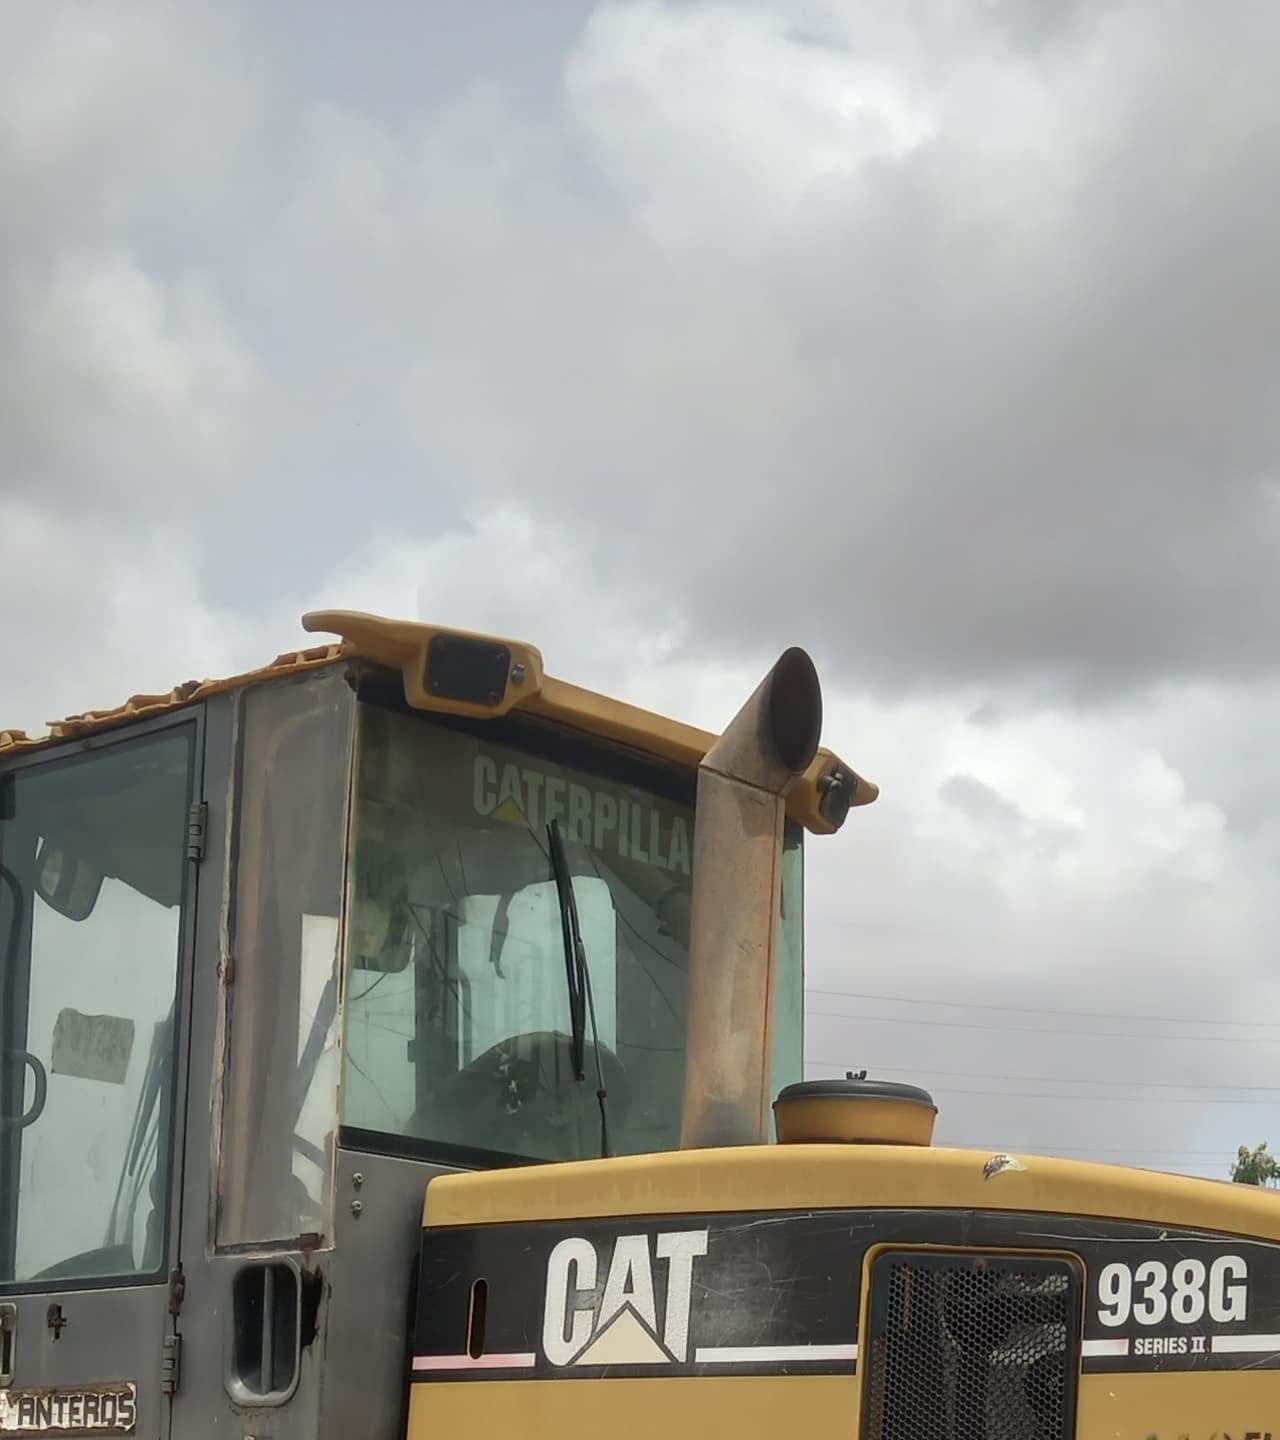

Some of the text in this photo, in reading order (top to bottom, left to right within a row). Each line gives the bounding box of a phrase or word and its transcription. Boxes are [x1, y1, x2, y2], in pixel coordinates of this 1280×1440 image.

[472, 755, 691, 876] CATERPILLA
[542, 1229, 709, 1367] CAT
[1097, 1255, 1248, 1328] 938G
[1134, 1335, 1206, 1355] SERIES II
